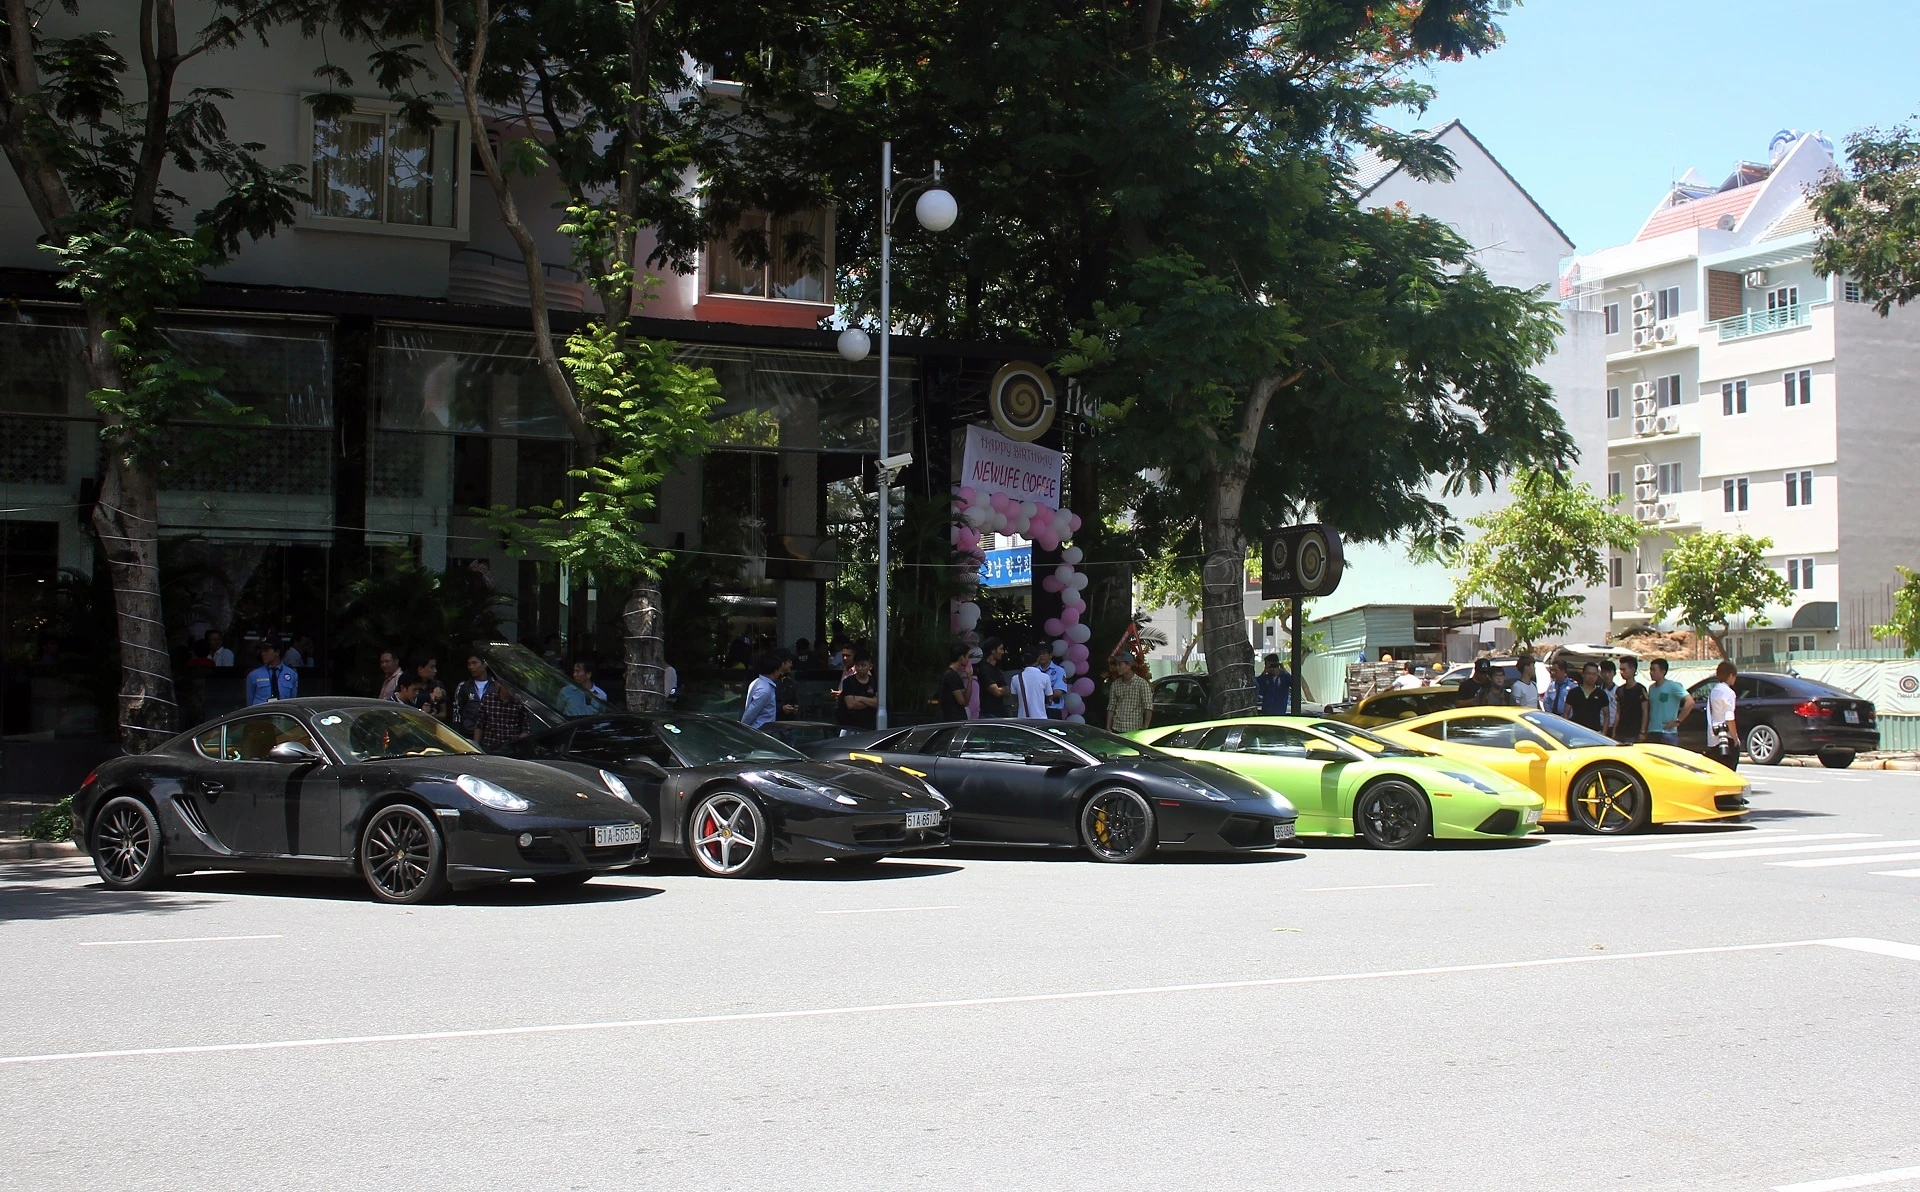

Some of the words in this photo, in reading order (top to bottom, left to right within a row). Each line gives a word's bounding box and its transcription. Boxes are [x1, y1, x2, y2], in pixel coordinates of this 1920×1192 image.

[980, 435, 1012, 458] HAPPY
[1012, 445, 1054, 469] BIRTHDAY
[1022, 471, 1057, 498] COFFEE
